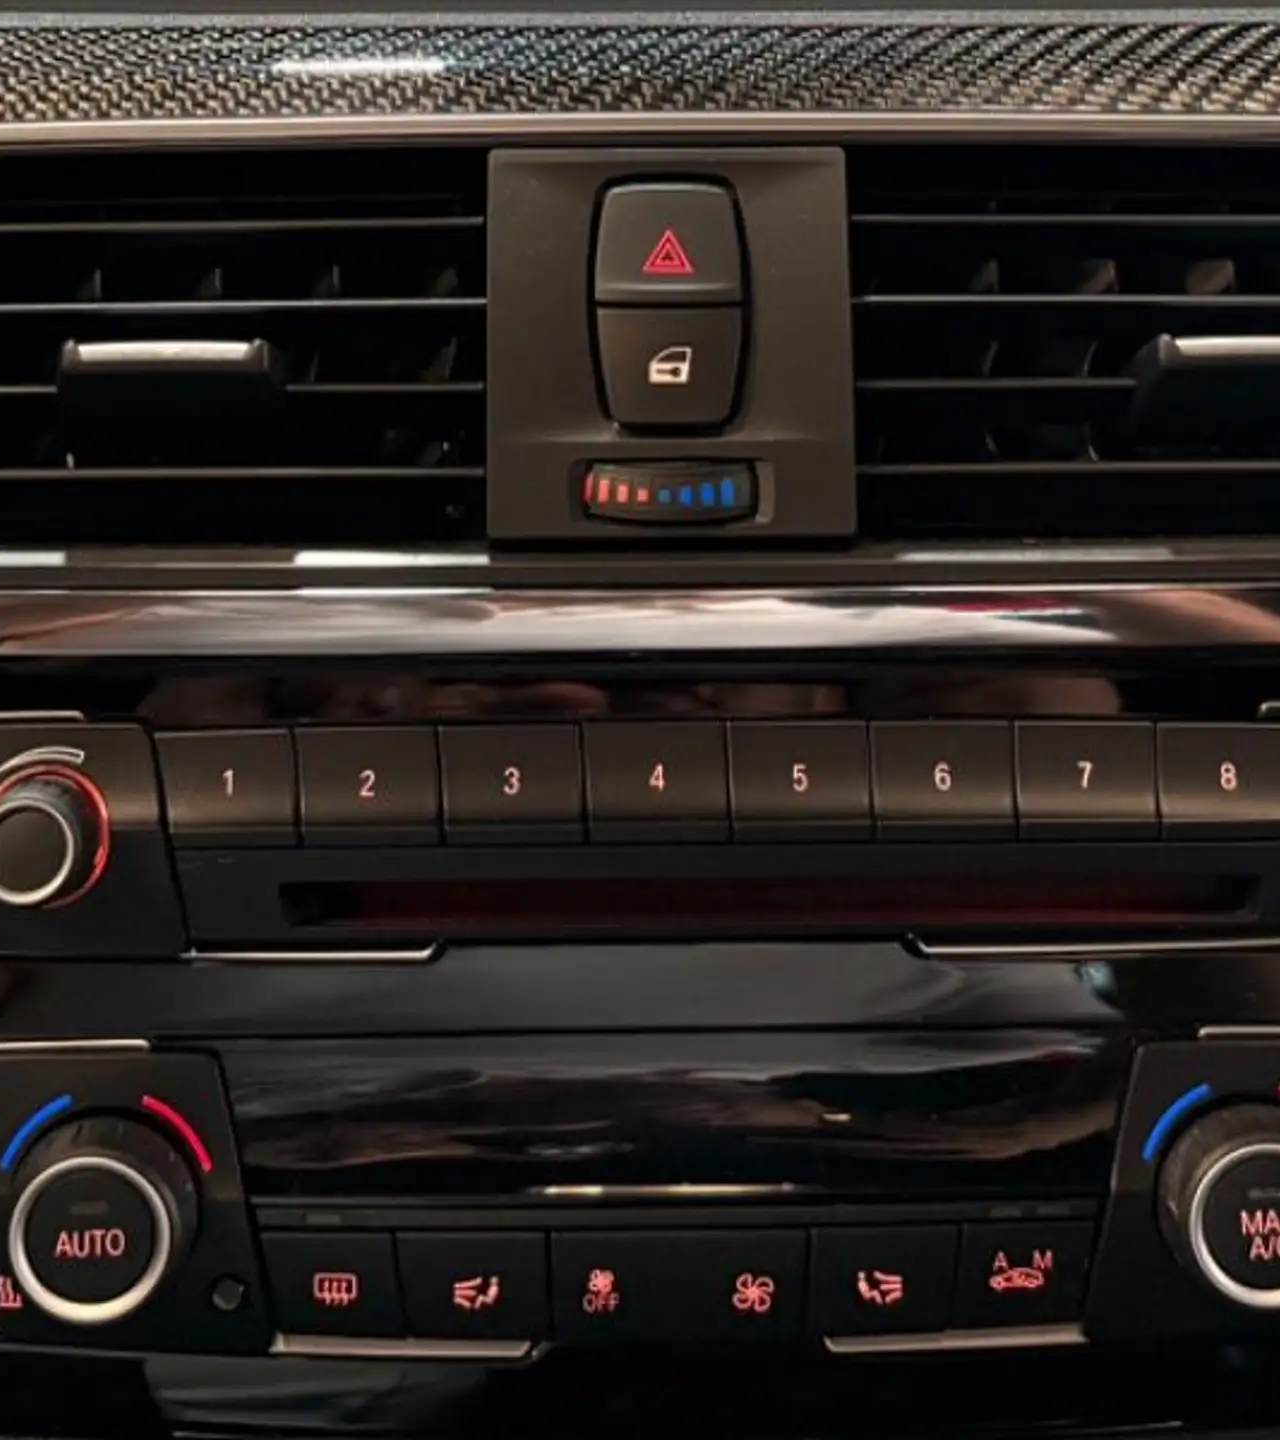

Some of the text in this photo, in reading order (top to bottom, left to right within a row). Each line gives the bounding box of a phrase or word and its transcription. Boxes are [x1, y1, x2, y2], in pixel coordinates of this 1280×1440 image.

[223, 769, 234, 796] 1
[359, 769, 376, 798] 2
[503, 766, 521, 796] 3
[649, 764, 665, 791] 4
[792, 763, 809, 792] 5
[934, 762, 952, 792] 6
[1077, 761, 1093, 789] 7
[1220, 761, 1238, 791] 8
[55, 1228, 126, 1258] AUTO
[992, 1249, 1053, 1271] A M
[582, 1287, 619, 1313] OFF
